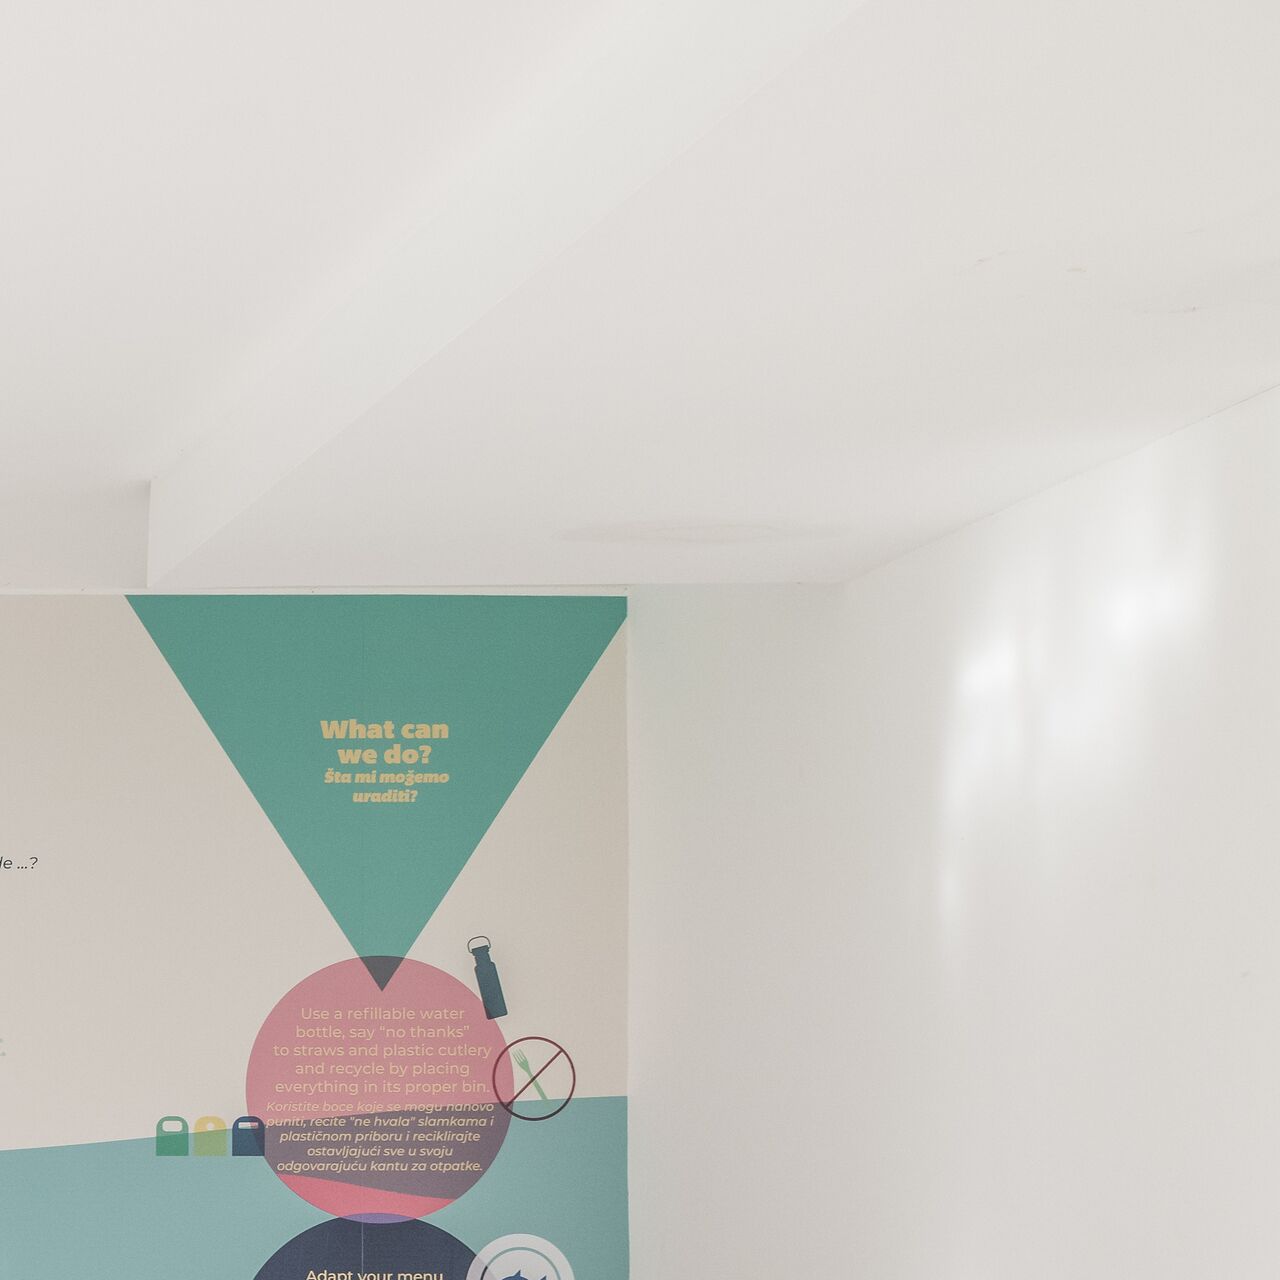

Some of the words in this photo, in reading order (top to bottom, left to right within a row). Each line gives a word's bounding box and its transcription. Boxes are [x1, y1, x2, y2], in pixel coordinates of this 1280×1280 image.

[319, 718, 396, 740] What
[400, 722, 450, 740] can
[336, 748, 379, 765] we
[383, 743, 433, 765] do?
[300, 1007, 331, 1021] Use
[333, 1009, 343, 1021] a
[346, 1006, 417, 1021] refillable
[419, 1007, 466, 1021] water
[295, 1024, 346, 1041] bottle,
[348, 1027, 376, 1042] say
[382, 1147, 406, 1157] sve
[407, 1147, 418, 1157] u
[418, 1144, 454, 1159] svoju
